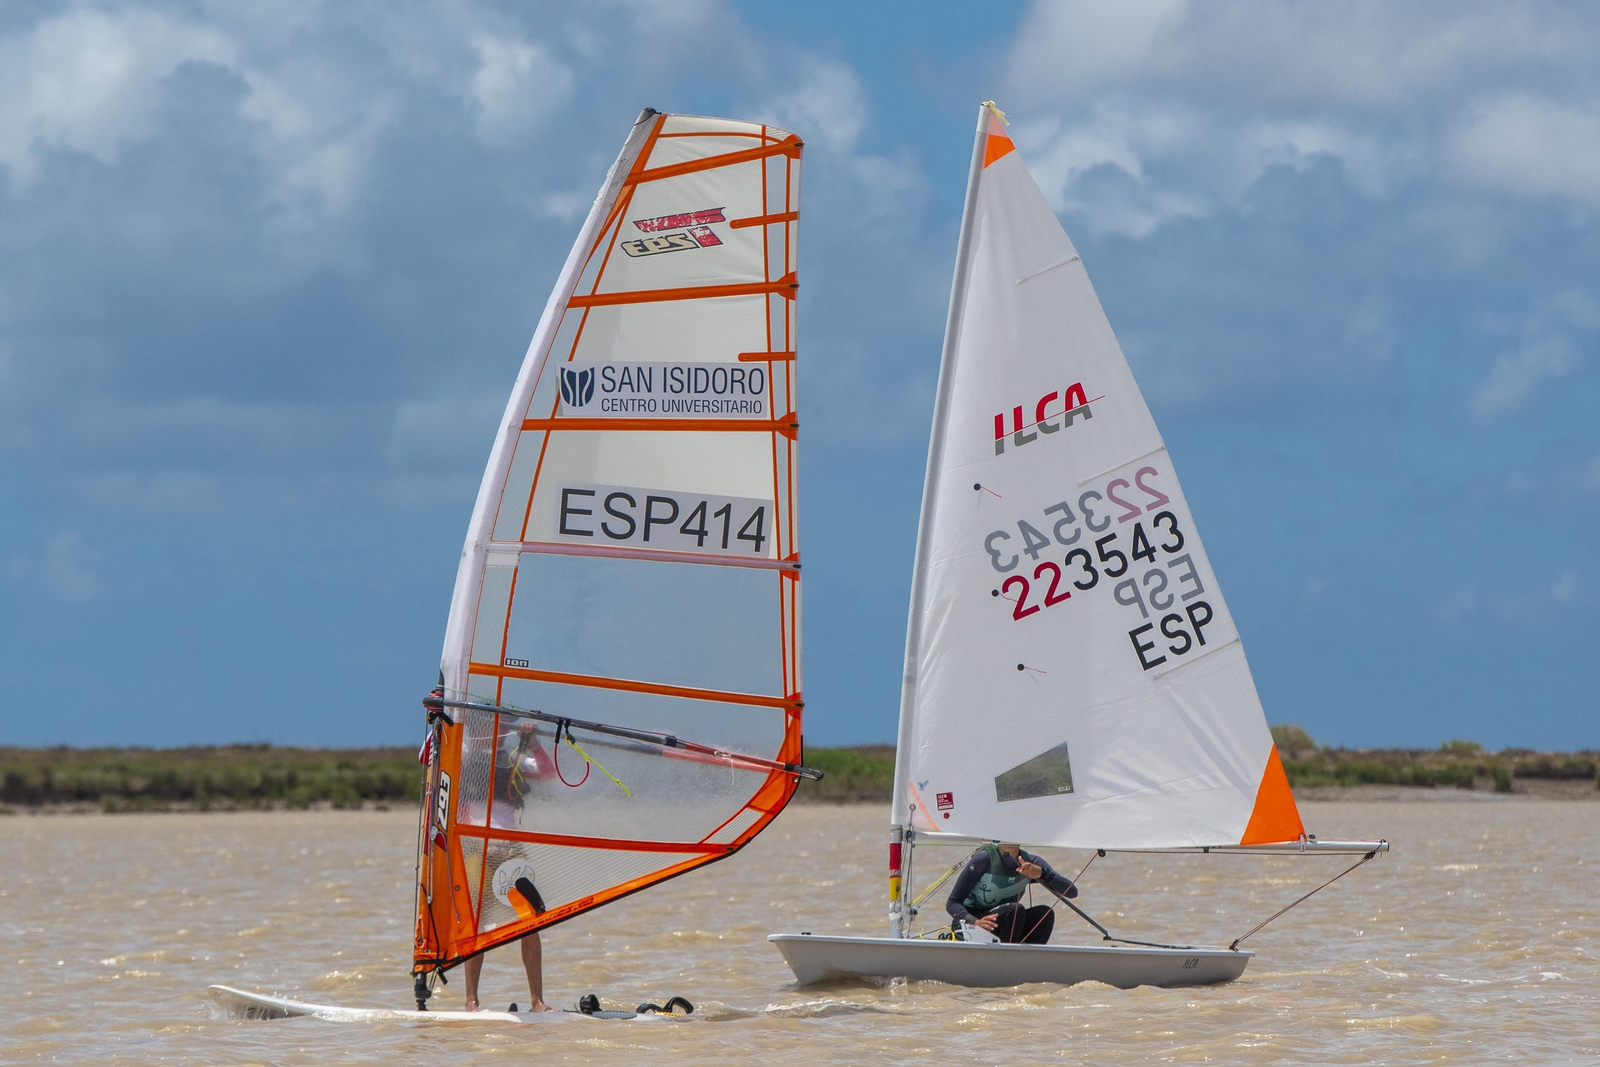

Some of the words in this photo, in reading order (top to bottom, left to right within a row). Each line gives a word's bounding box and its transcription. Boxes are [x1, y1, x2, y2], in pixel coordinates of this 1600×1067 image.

[601, 365, 653, 393] SAN
[663, 366, 765, 396] ISIDORO
[601, 398, 657, 413] CENTRO
[661, 398, 762, 414] UNIVERSITARIO
[994, 382, 1093, 456] ILCA
[559, 488, 766, 552] ESP414
[1002, 511, 1185, 621] 223543
[1128, 601, 1213, 671] ESP
